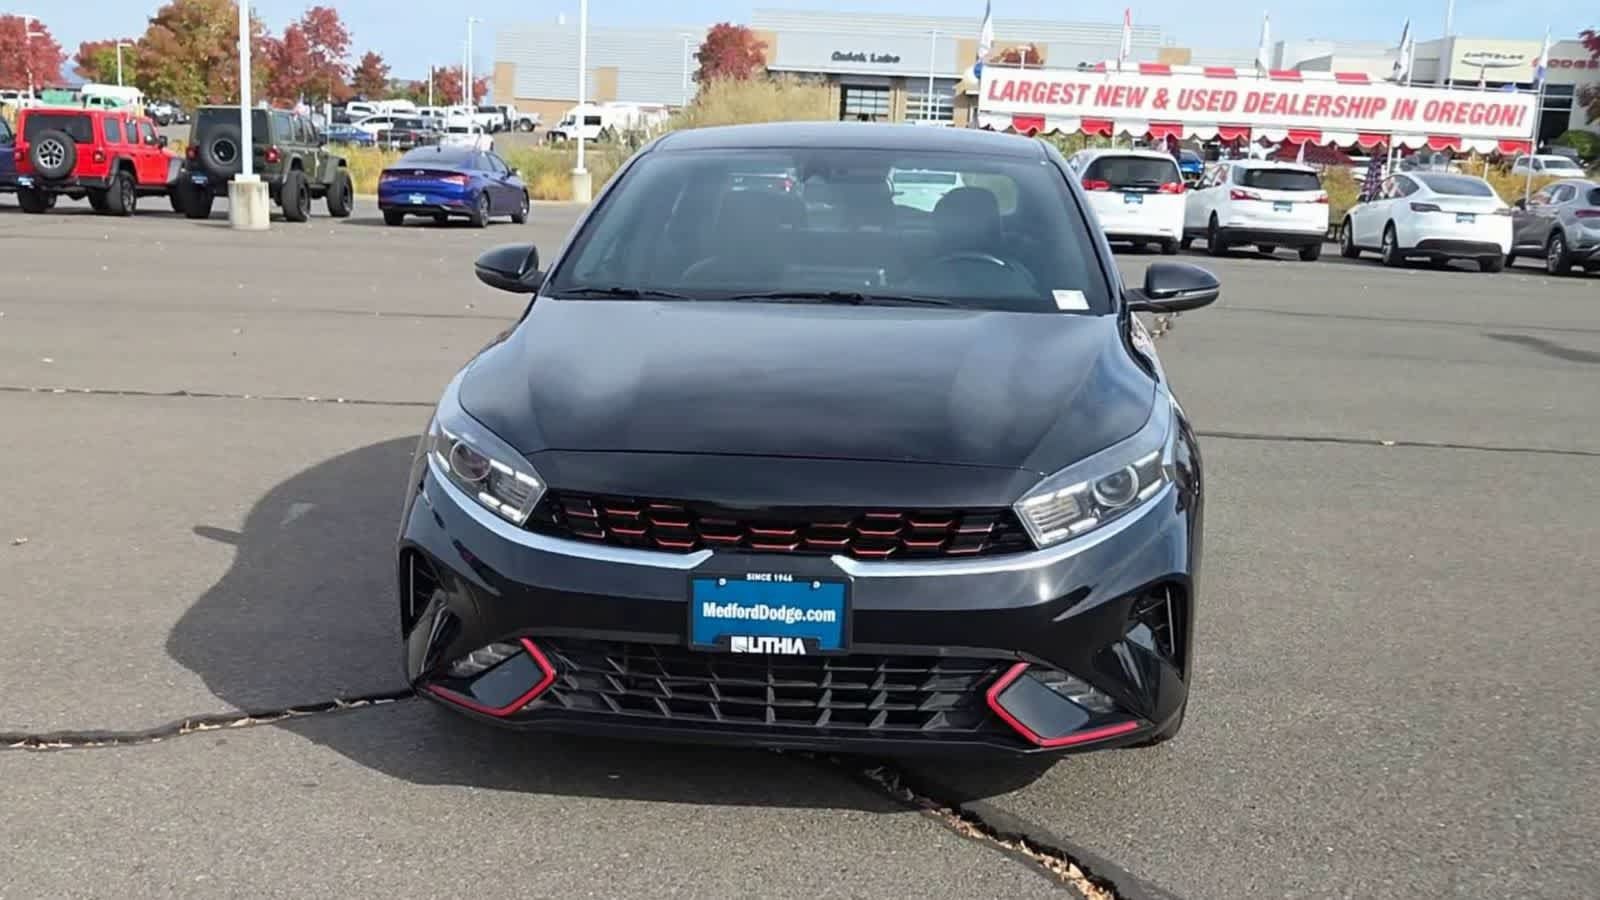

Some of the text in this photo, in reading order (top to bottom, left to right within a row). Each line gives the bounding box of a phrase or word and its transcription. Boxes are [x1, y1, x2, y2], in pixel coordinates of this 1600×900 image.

[987, 79, 1527, 127] LARGEST NEW & USED DEALERSHIP IN OREGON!
[746, 573, 771, 582] SINCE
[703, 602, 836, 624] MedfordDodge.com
[748, 636, 806, 655] LITHIA
